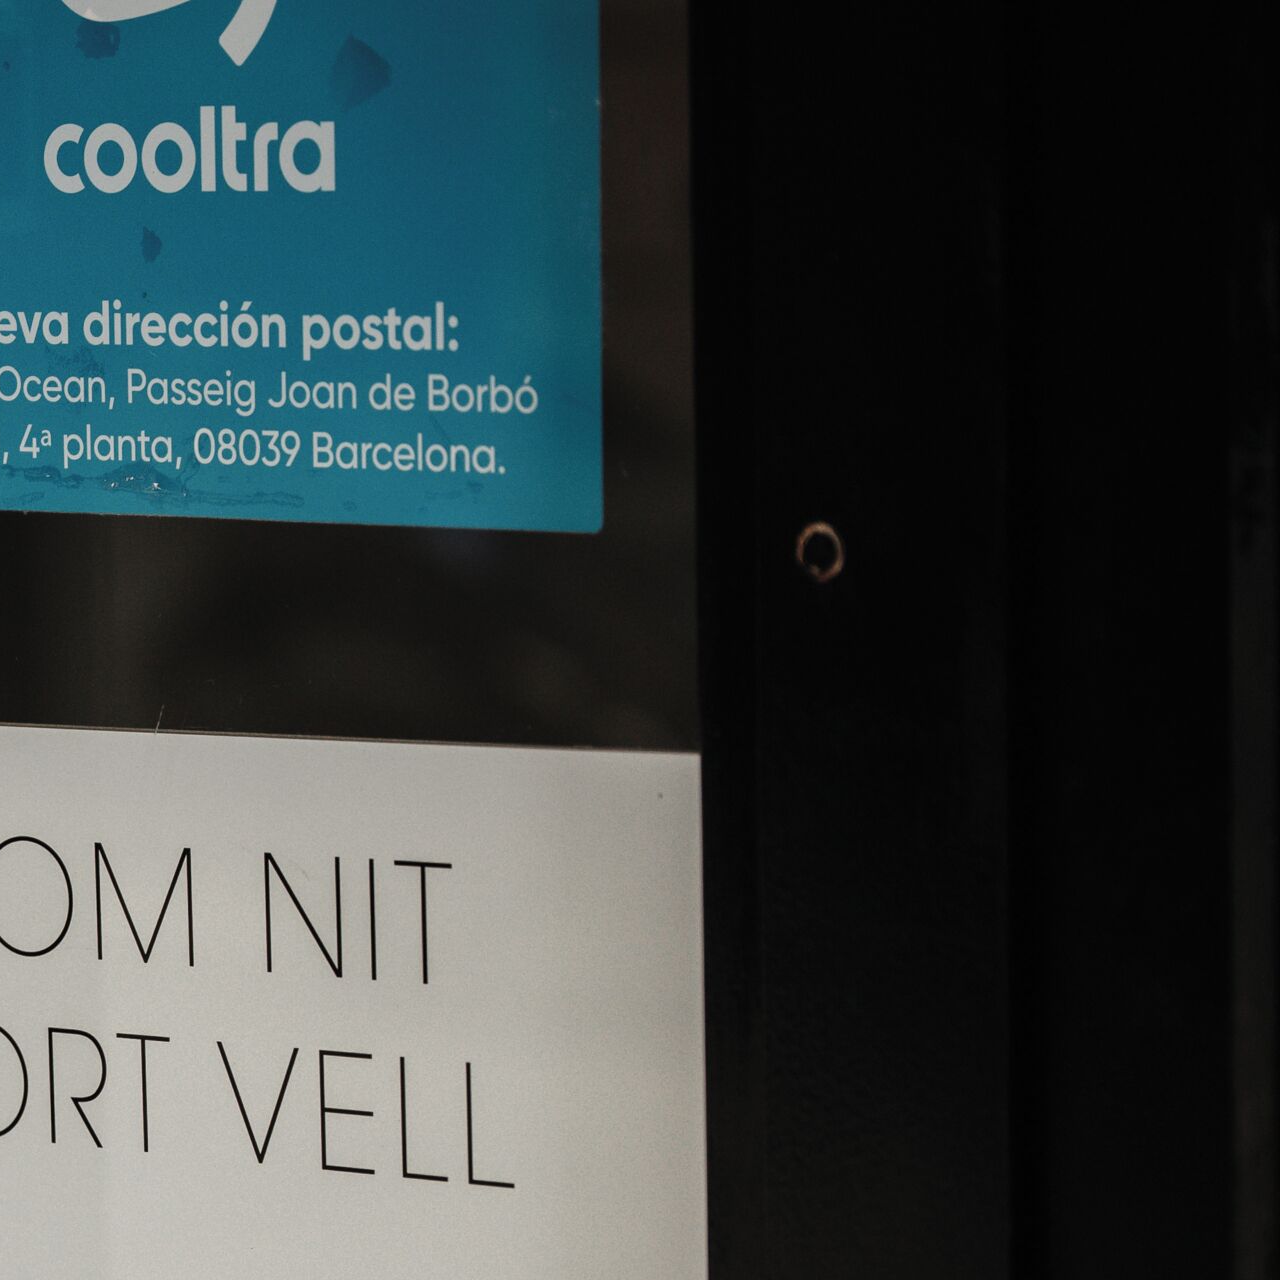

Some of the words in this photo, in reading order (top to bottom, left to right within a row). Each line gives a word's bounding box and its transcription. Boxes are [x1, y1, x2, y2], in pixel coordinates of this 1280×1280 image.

[42, 104, 336, 194] cooltra
[83, 298, 287, 350] dirección
[300, 300, 459, 360] postal:
[127, 370, 258, 420] Passeig
[268, 373, 357, 413] Joan
[368, 374, 416, 413] de
[427, 374, 538, 417] Borbó
[61, 426, 184, 473] planta,
[192, 429, 301, 470] 08039
[311, 431, 506, 476] Barcelona.
[265, 851, 453, 985] NIT
[215, 1039, 515, 1190] VELL
